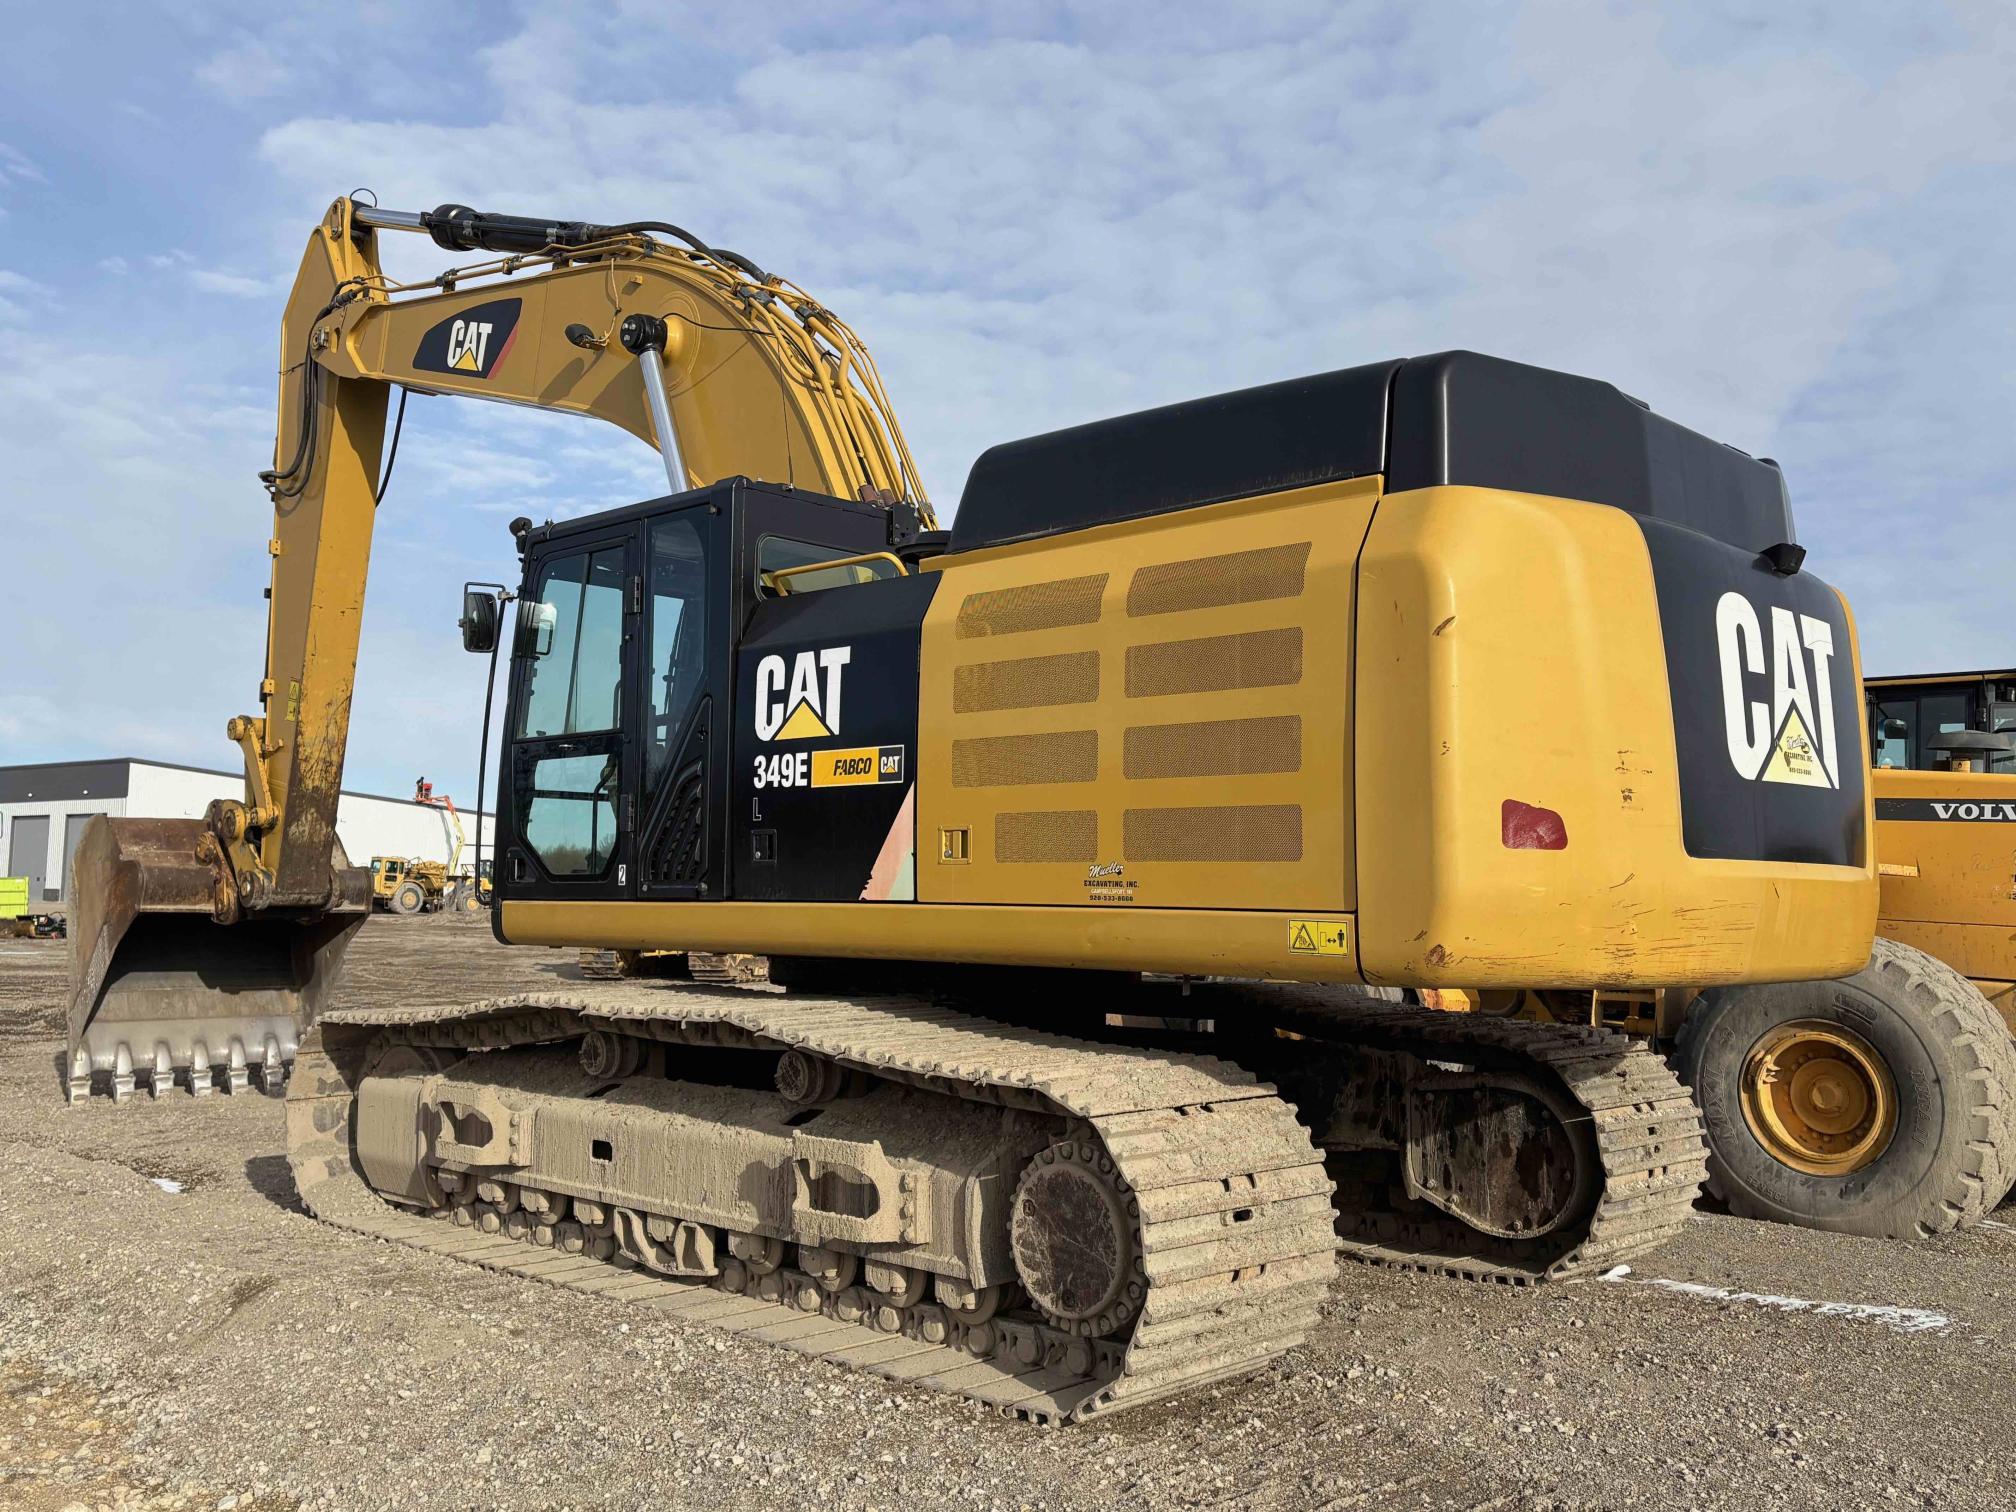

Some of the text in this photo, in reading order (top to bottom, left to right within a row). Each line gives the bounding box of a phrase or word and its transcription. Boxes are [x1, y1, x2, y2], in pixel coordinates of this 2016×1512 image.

[446, 319, 493, 372] CAT
[754, 645, 851, 741] CAT
[1715, 591, 1840, 790] CAT
[753, 751, 808, 789] 349E
[833, 756, 873, 776] FABCO
[880, 754, 900, 774] CAT
[752, 797, 762, 822] L
[1930, 803, 2016, 820] VOLV
[619, 865, 625, 885] 2
